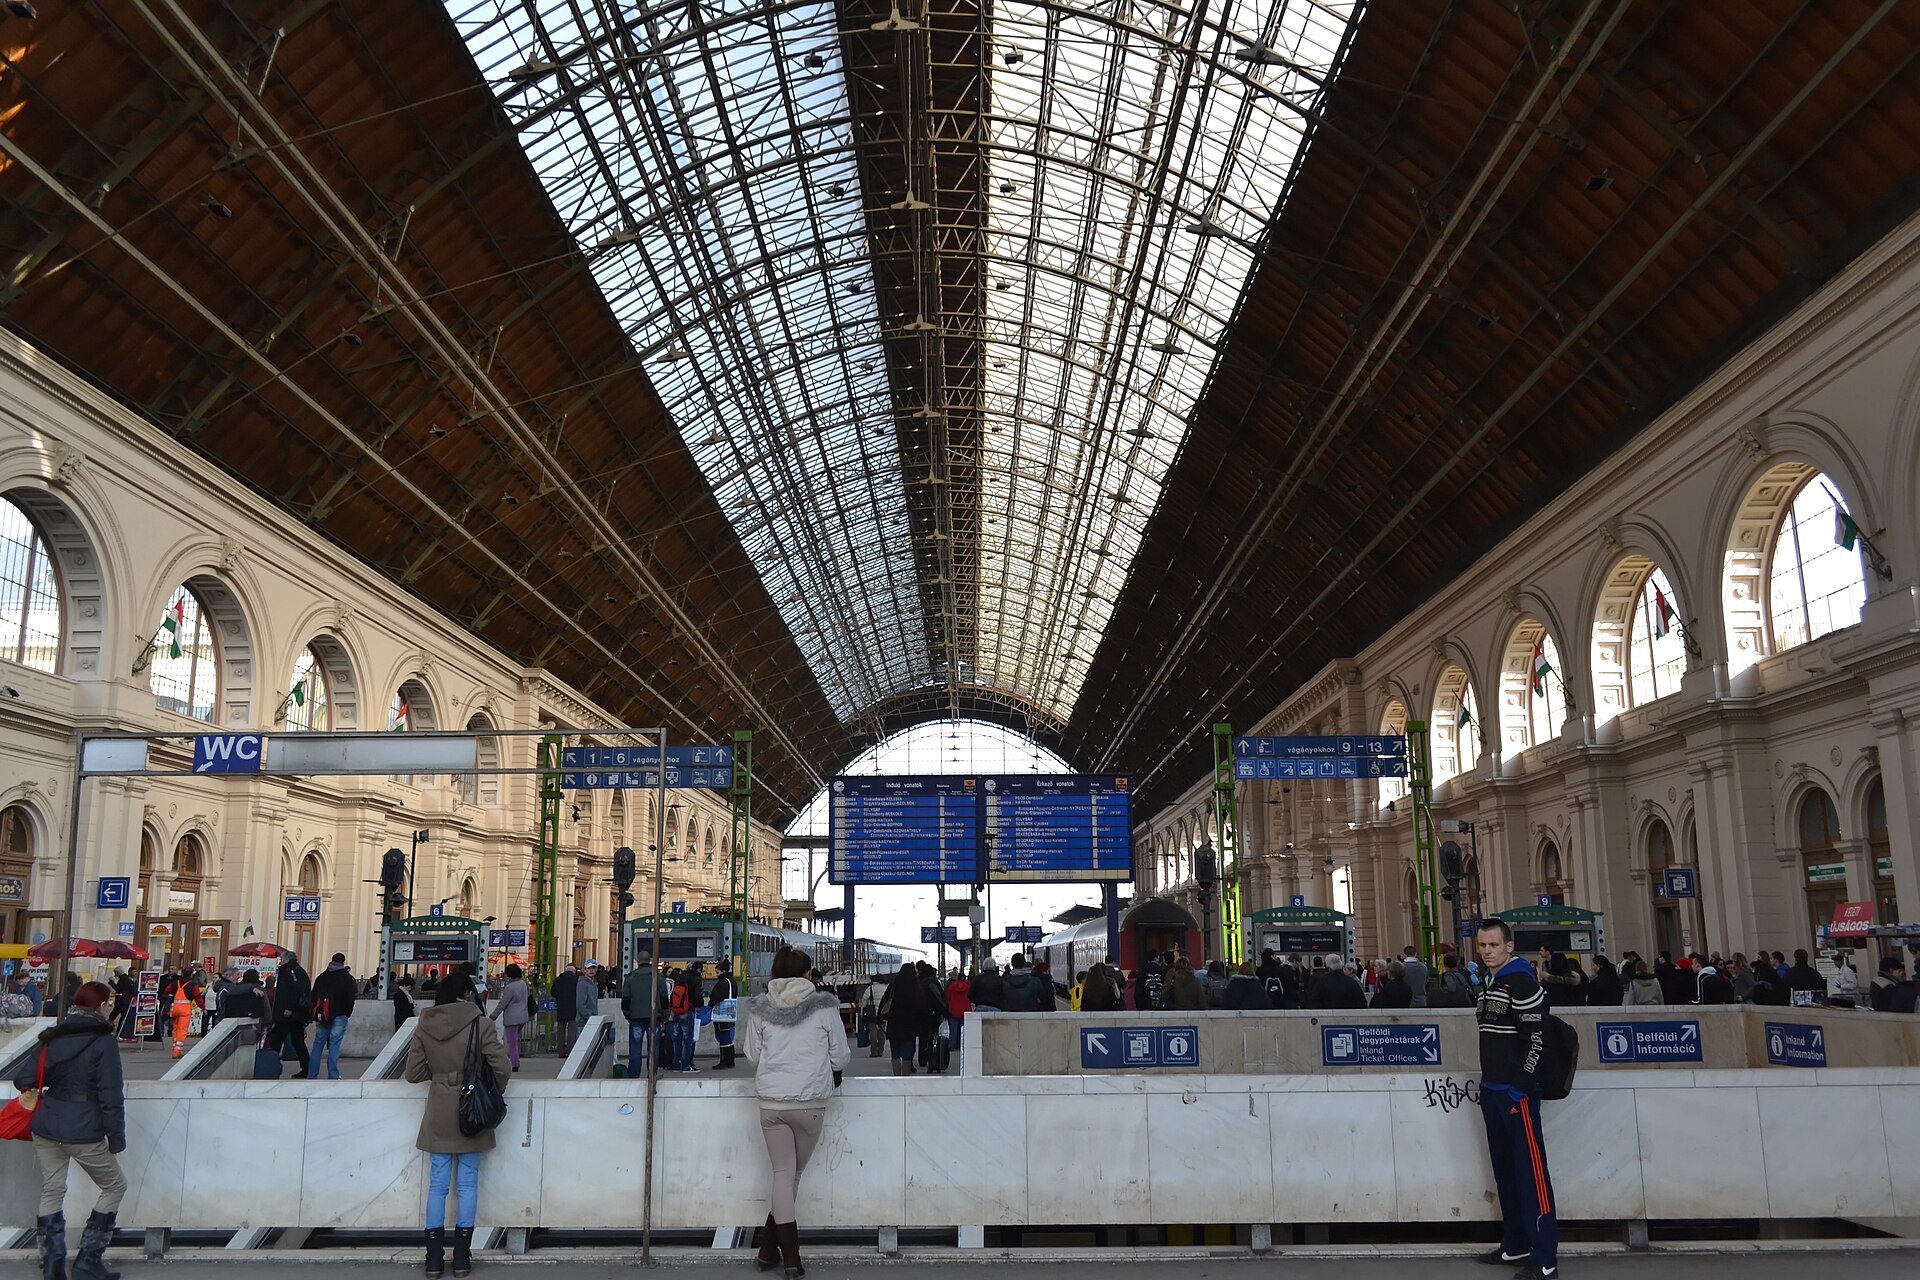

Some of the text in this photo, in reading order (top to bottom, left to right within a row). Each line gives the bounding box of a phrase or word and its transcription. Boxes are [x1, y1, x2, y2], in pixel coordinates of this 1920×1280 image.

[203, 735, 258, 760] WC
[1342, 743, 1351, 753] 9
[1368, 742, 1383, 753] 13
[589, 753, 595, 764] 1
[616, 753, 626, 764] 6
[1294, 898, 1301, 906] 8
[1541, 897, 1549, 906] 9
[433, 907, 440, 916] 6
[675, 904, 682, 912] 7
[1359, 1028, 1390, 1036] Belföldi
[1636, 1032, 1678, 1042] Belföldi
[1360, 1036, 1420, 1045] Jegypénztárak
[1785, 1034, 1805, 1046] Inland
[1637, 1043, 1696, 1054] Információ
[1787, 1047, 1825, 1061] Information
